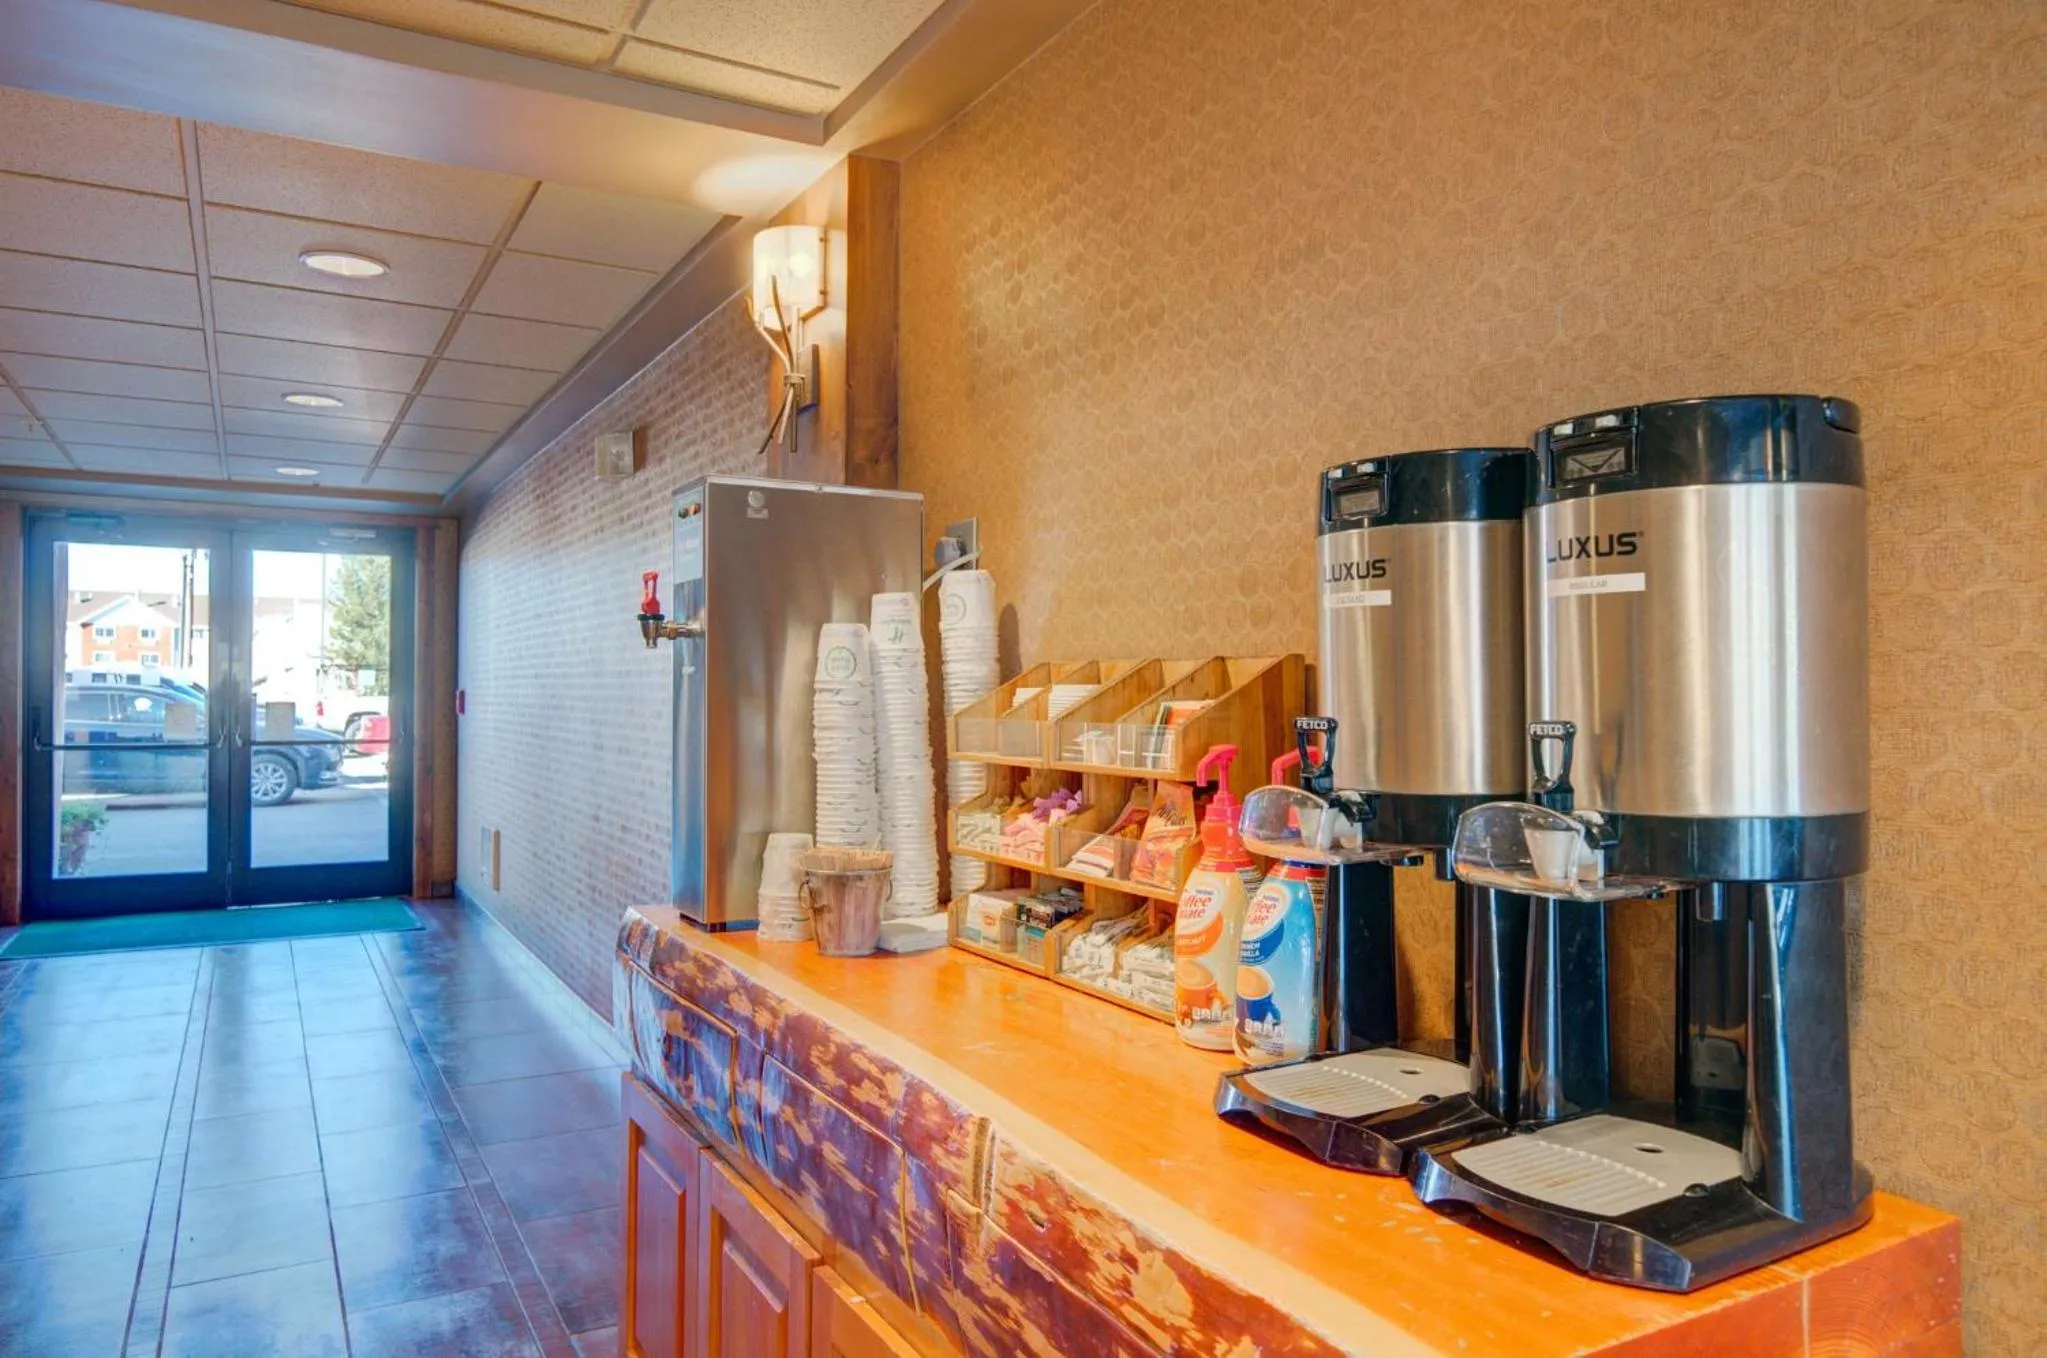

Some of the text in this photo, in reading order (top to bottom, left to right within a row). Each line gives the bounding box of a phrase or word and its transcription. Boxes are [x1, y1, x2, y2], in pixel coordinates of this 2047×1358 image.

[1546, 531, 1638, 563] LUXUS
[1323, 558, 1387, 583] LUXUS
[1296, 719, 1328, 730] FETCO
[1530, 723, 1563, 736] FETCO
